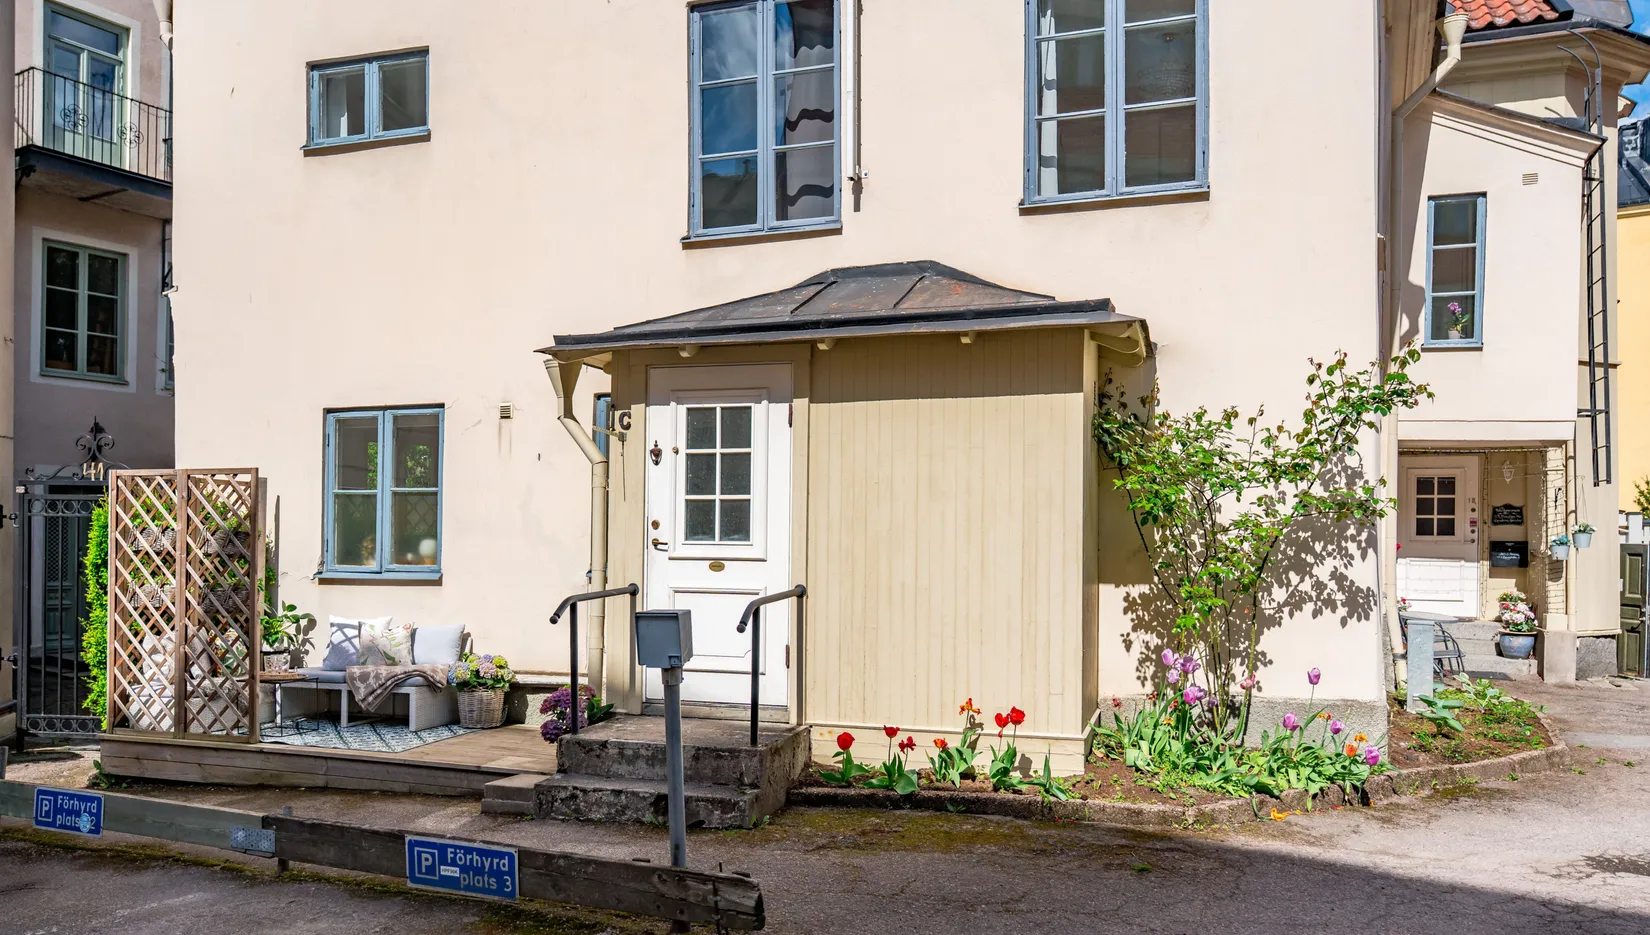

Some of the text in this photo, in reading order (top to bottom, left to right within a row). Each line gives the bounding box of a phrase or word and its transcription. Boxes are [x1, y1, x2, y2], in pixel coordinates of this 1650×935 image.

[83, 462, 104, 481] 41
[42, 800, 50, 817] P
[57, 795, 97, 814] Förhyrd
[56, 812, 81, 828] plats
[421, 853, 433, 873] P
[447, 847, 509, 872] Förhyrd
[460, 871, 512, 892] plats 3
